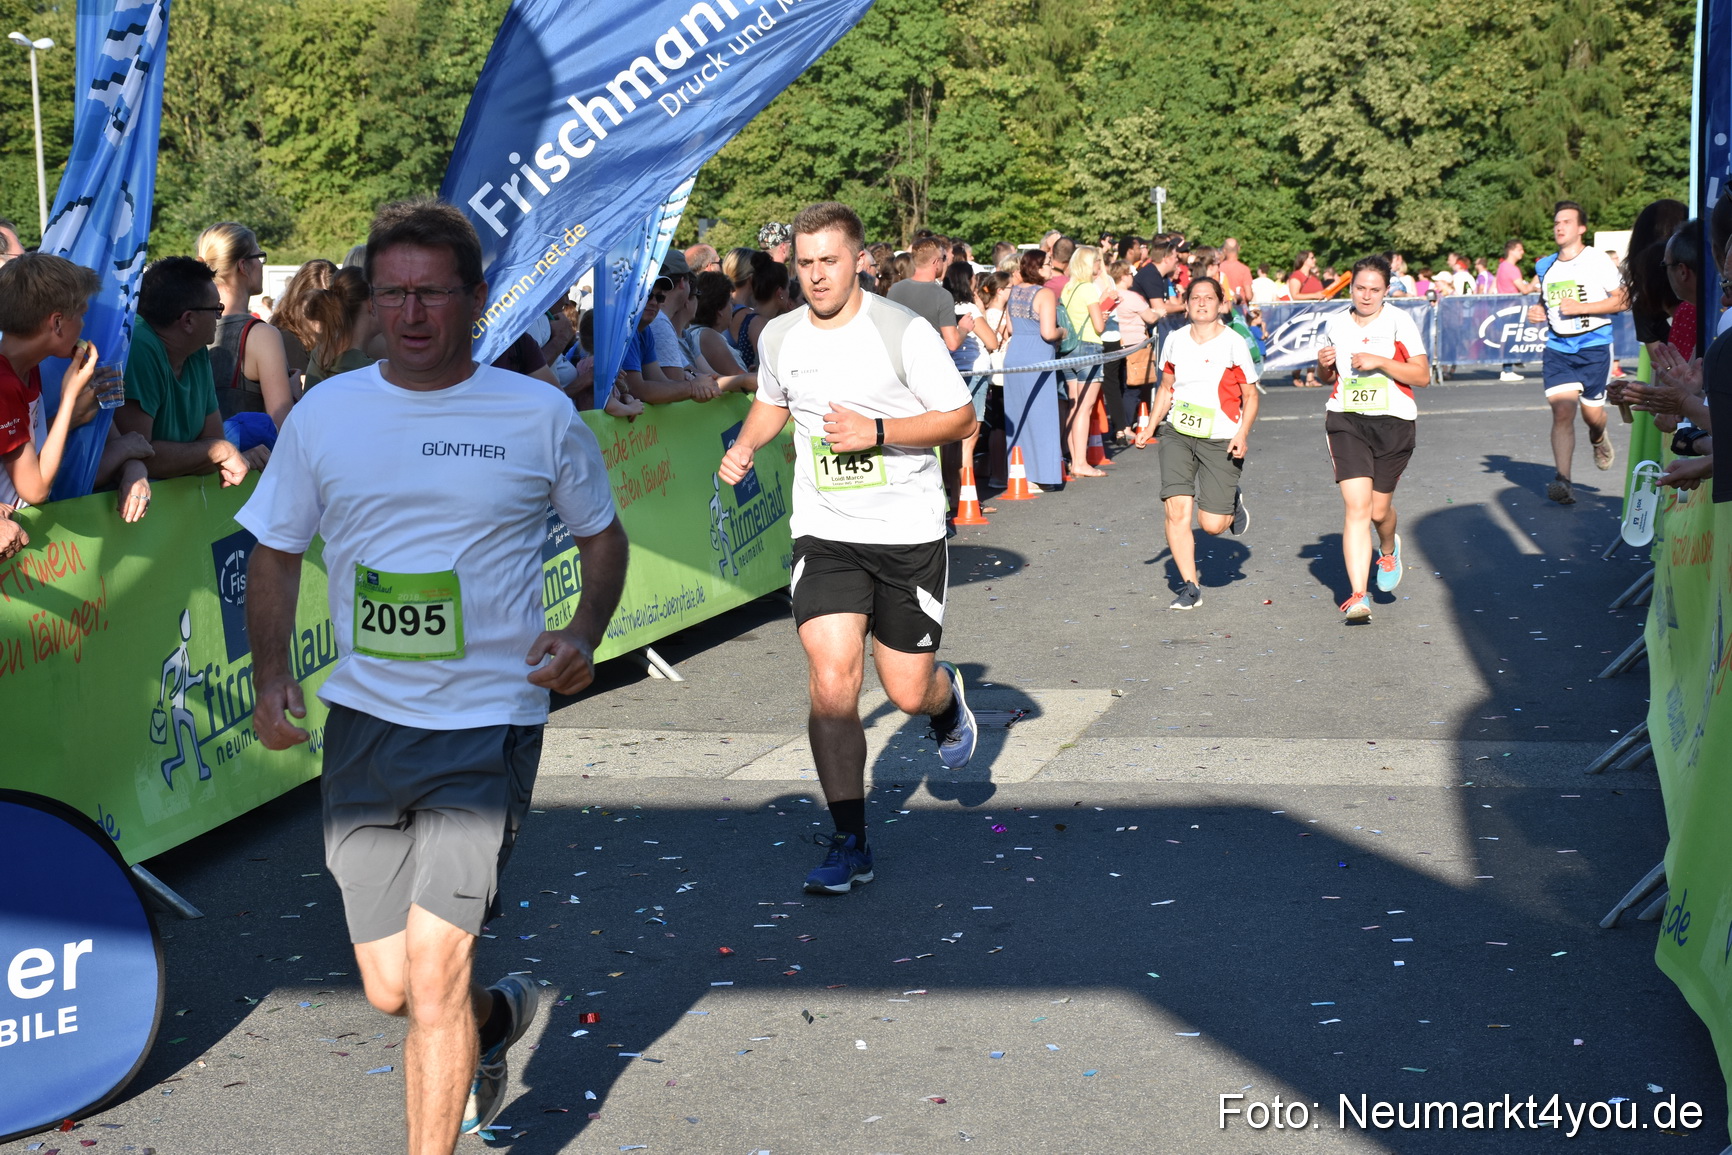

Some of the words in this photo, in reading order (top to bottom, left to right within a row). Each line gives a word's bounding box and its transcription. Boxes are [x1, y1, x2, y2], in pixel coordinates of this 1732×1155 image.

[657, 52, 730, 118] Druck
[728, 5, 777, 55] und
[471, 223, 588, 343] chmann-net.de
[1551, 289, 1574, 300] 2102
[1352, 389, 1377, 402] 267
[1179, 412, 1202, 428] 251
[422, 440, 506, 461] GÜNTHER
[820, 453, 874, 476] 1145
[729, 470, 787, 549] firmenlauf
[738, 536, 766, 569] neumarkt
[28, 575, 109, 665] länger!
[361, 599, 446, 637] 2095
[546, 599, 572, 632] markt
[7, 938, 93, 1000] er
[0, 1005, 79, 1048] BILE
